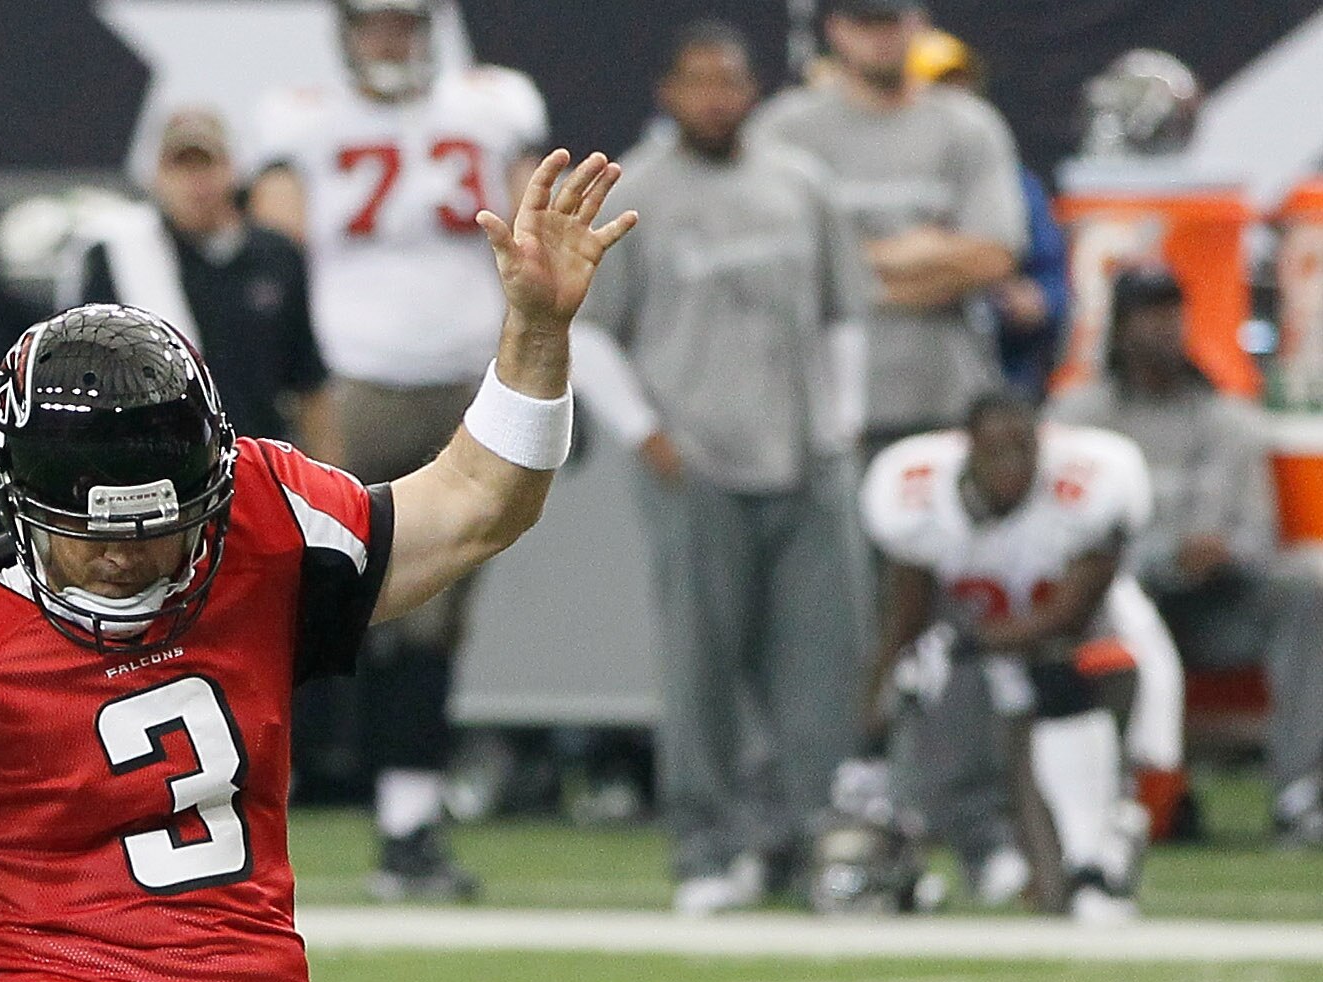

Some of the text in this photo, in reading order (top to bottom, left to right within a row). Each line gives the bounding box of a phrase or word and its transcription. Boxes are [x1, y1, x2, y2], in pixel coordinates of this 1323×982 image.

[337, 138, 488, 235] 73
[105, 646, 184, 679] FALCONS
[96, 674, 251, 892] 3
